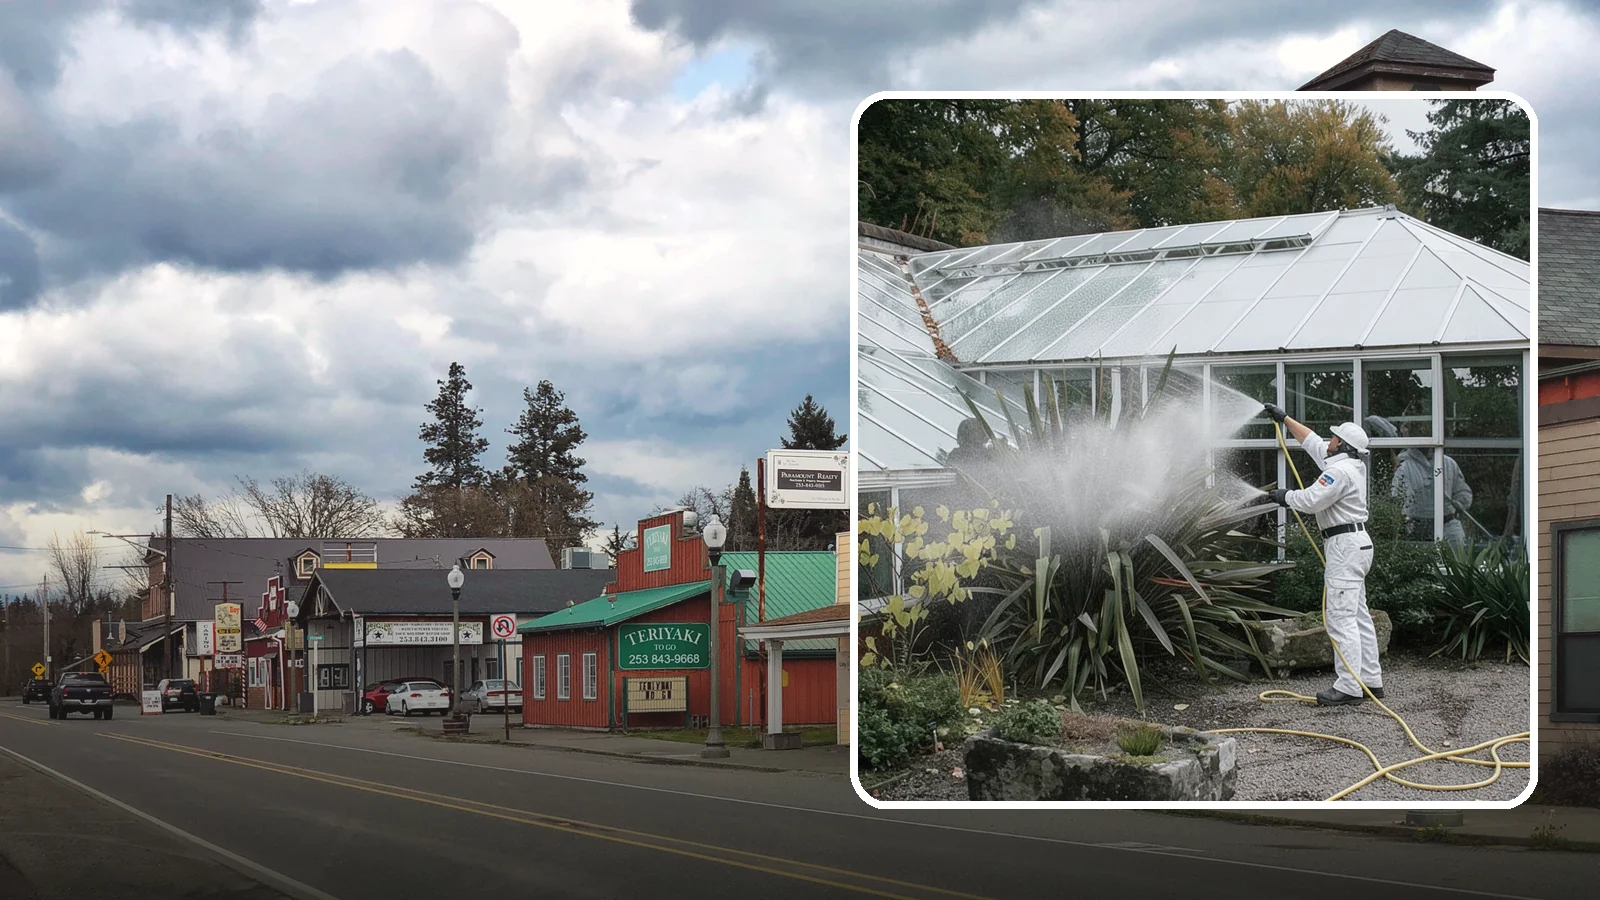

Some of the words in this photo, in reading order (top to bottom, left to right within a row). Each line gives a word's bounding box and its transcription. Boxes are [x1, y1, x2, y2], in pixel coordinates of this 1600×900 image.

[230, 606, 240, 614] Roy
[625, 627, 703, 646] TERIYAKI
[653, 643, 665, 651] TO
[665, 643, 677, 651] GO
[628, 654, 649, 665] 253
[651, 653, 701, 665] 843-9668
